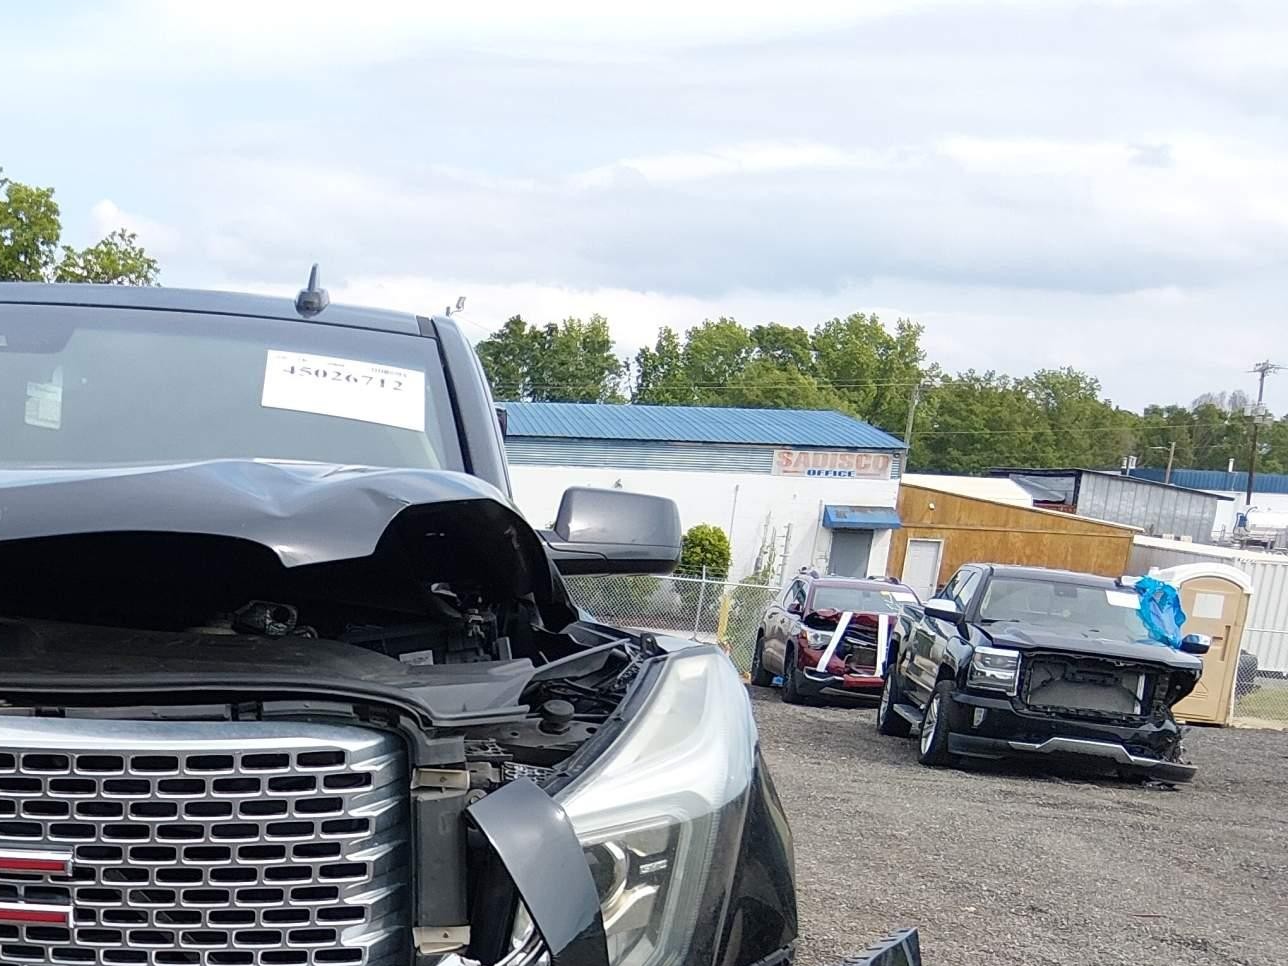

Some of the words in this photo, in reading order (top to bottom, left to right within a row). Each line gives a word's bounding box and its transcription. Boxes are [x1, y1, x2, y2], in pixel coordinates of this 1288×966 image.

[283, 365, 404, 392] 45026712
[777, 451, 890, 471] SADISCO
[807, 469, 857, 478] OFFICE
